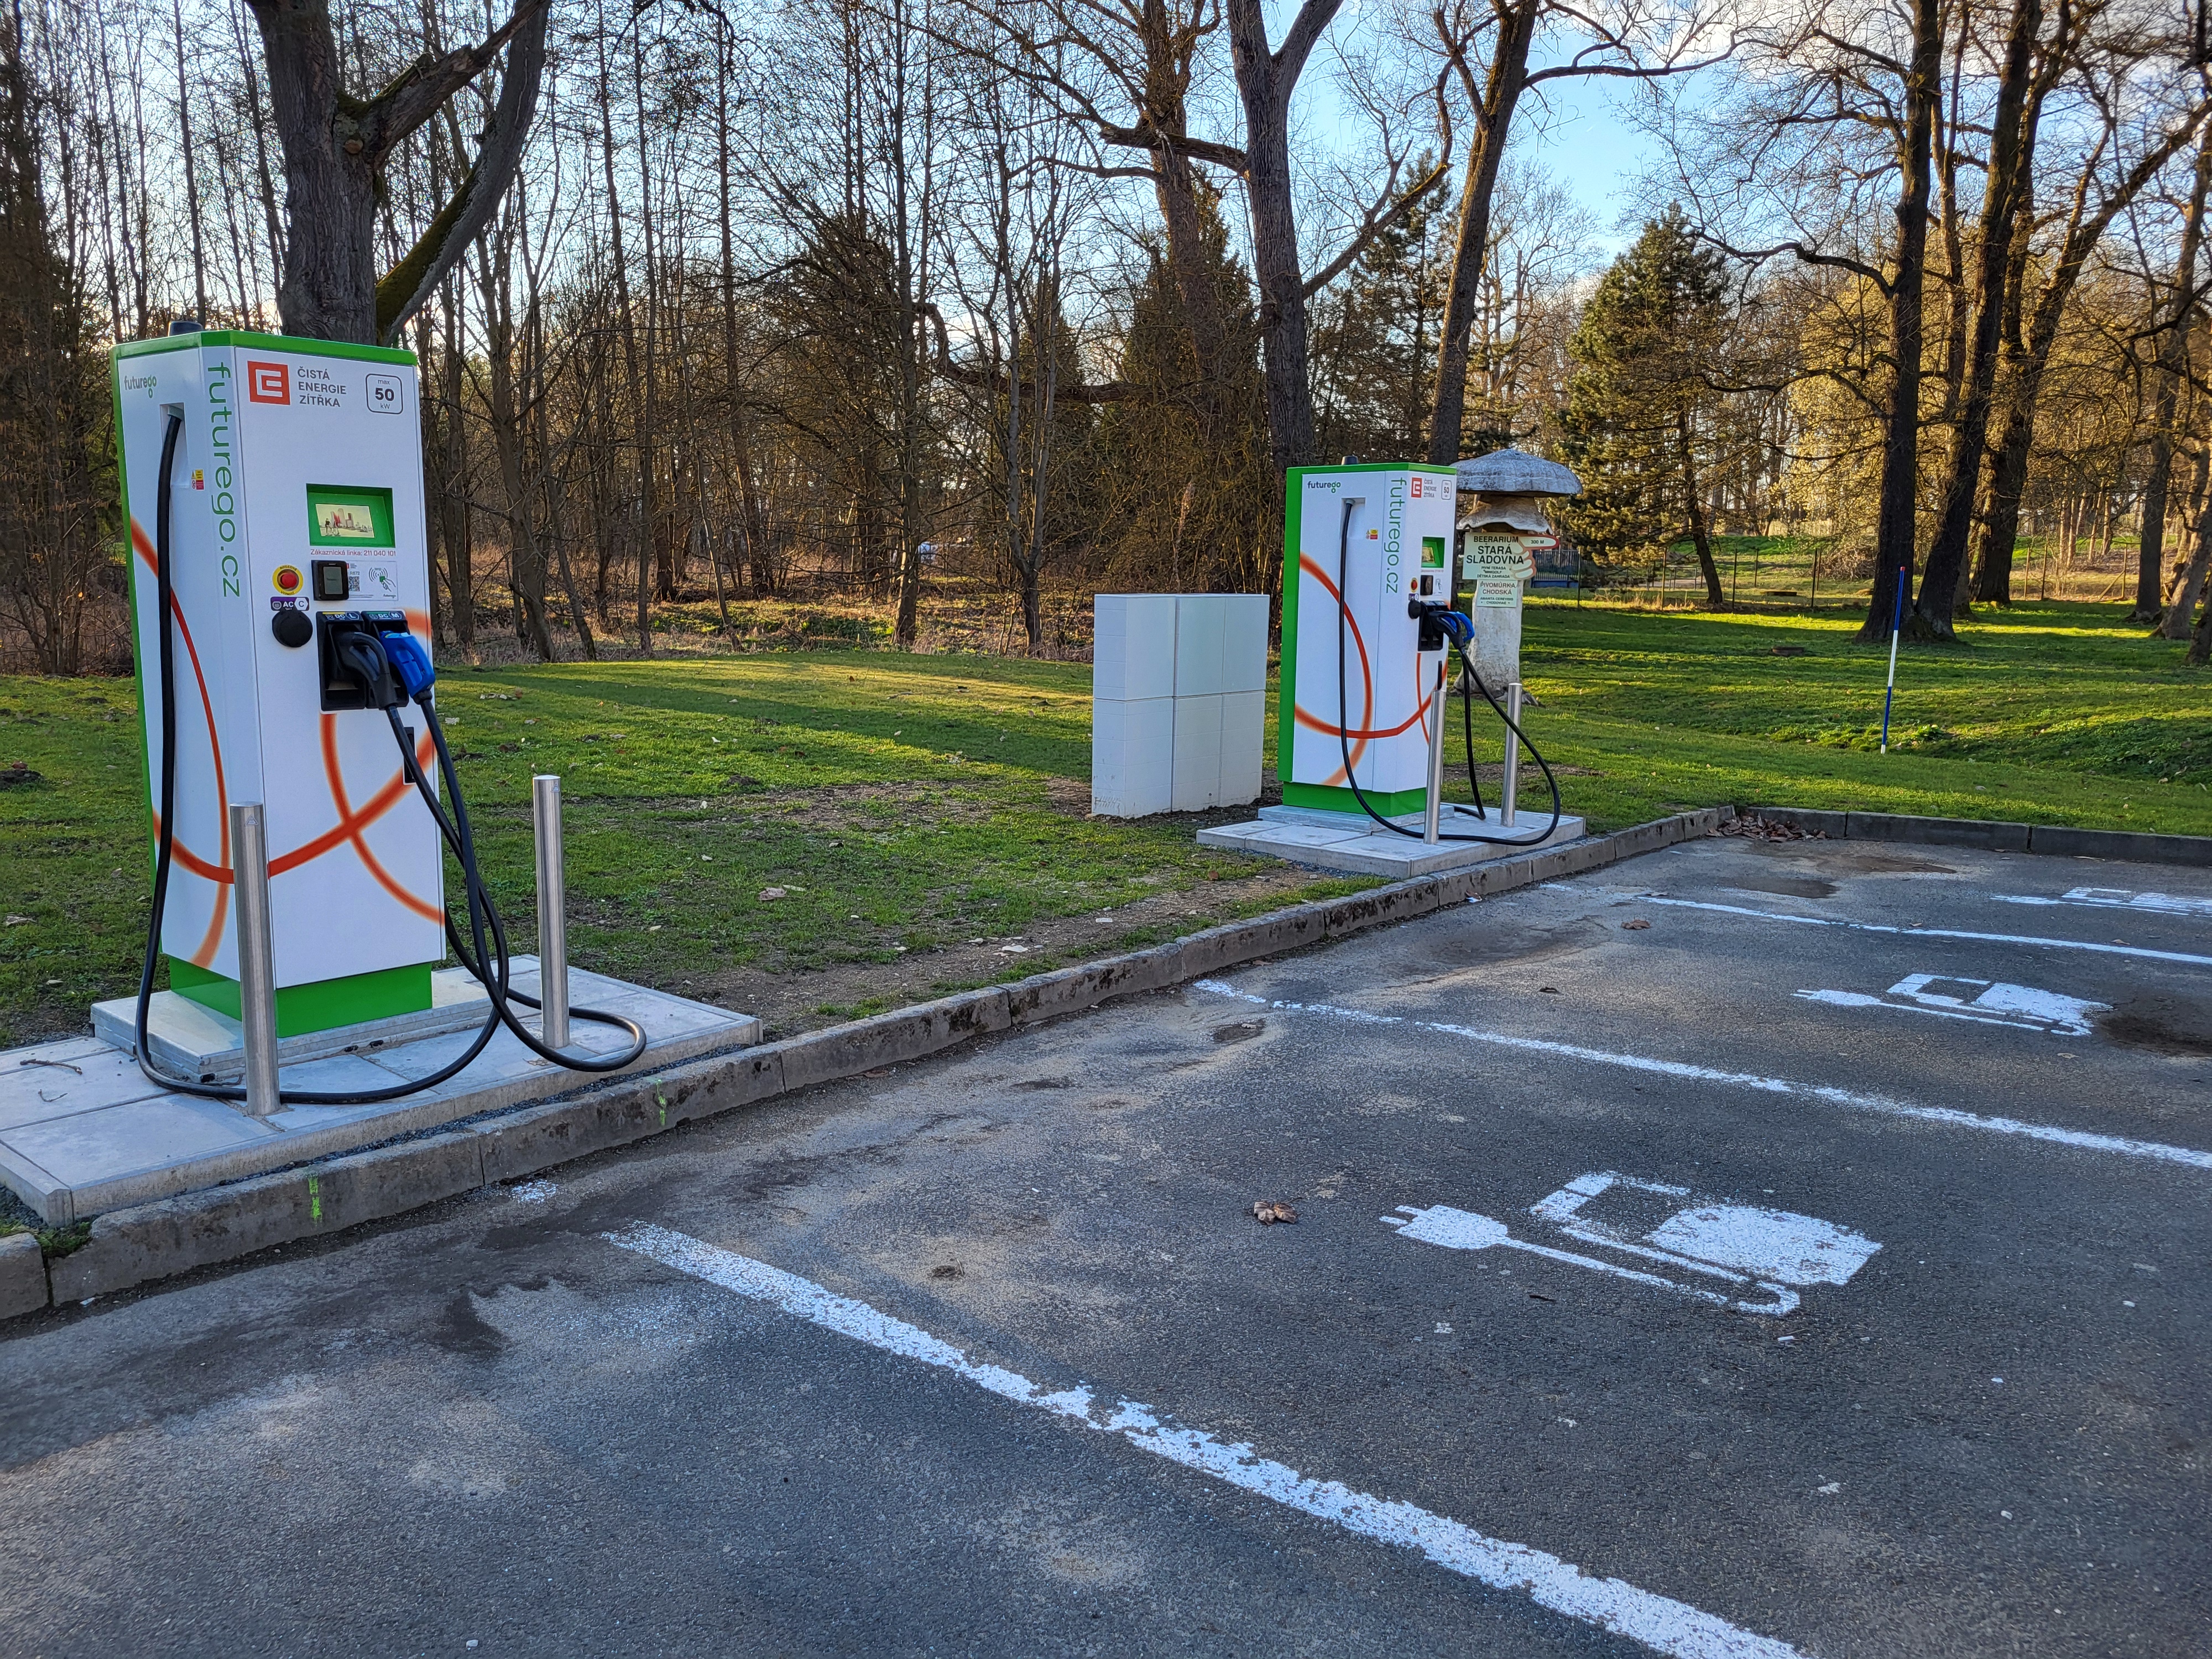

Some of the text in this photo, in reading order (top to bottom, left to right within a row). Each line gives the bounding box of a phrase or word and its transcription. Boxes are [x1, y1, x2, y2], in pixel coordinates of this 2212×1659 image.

[297, 366, 330, 380] ČISTÁ
[124, 374, 157, 398] futurego
[298, 381, 347, 394] ENERGIE
[299, 394, 341, 407] ZÍTŘKA
[374, 388, 395, 401] 50
[207, 362, 240, 597] futurego.cz
[1307, 481, 1341, 493] futurego
[1384, 477, 1407, 594] futurego.cz
[1478, 544, 1512, 555] STARÁ
[1466, 555, 1524, 564] SLADOVNA
